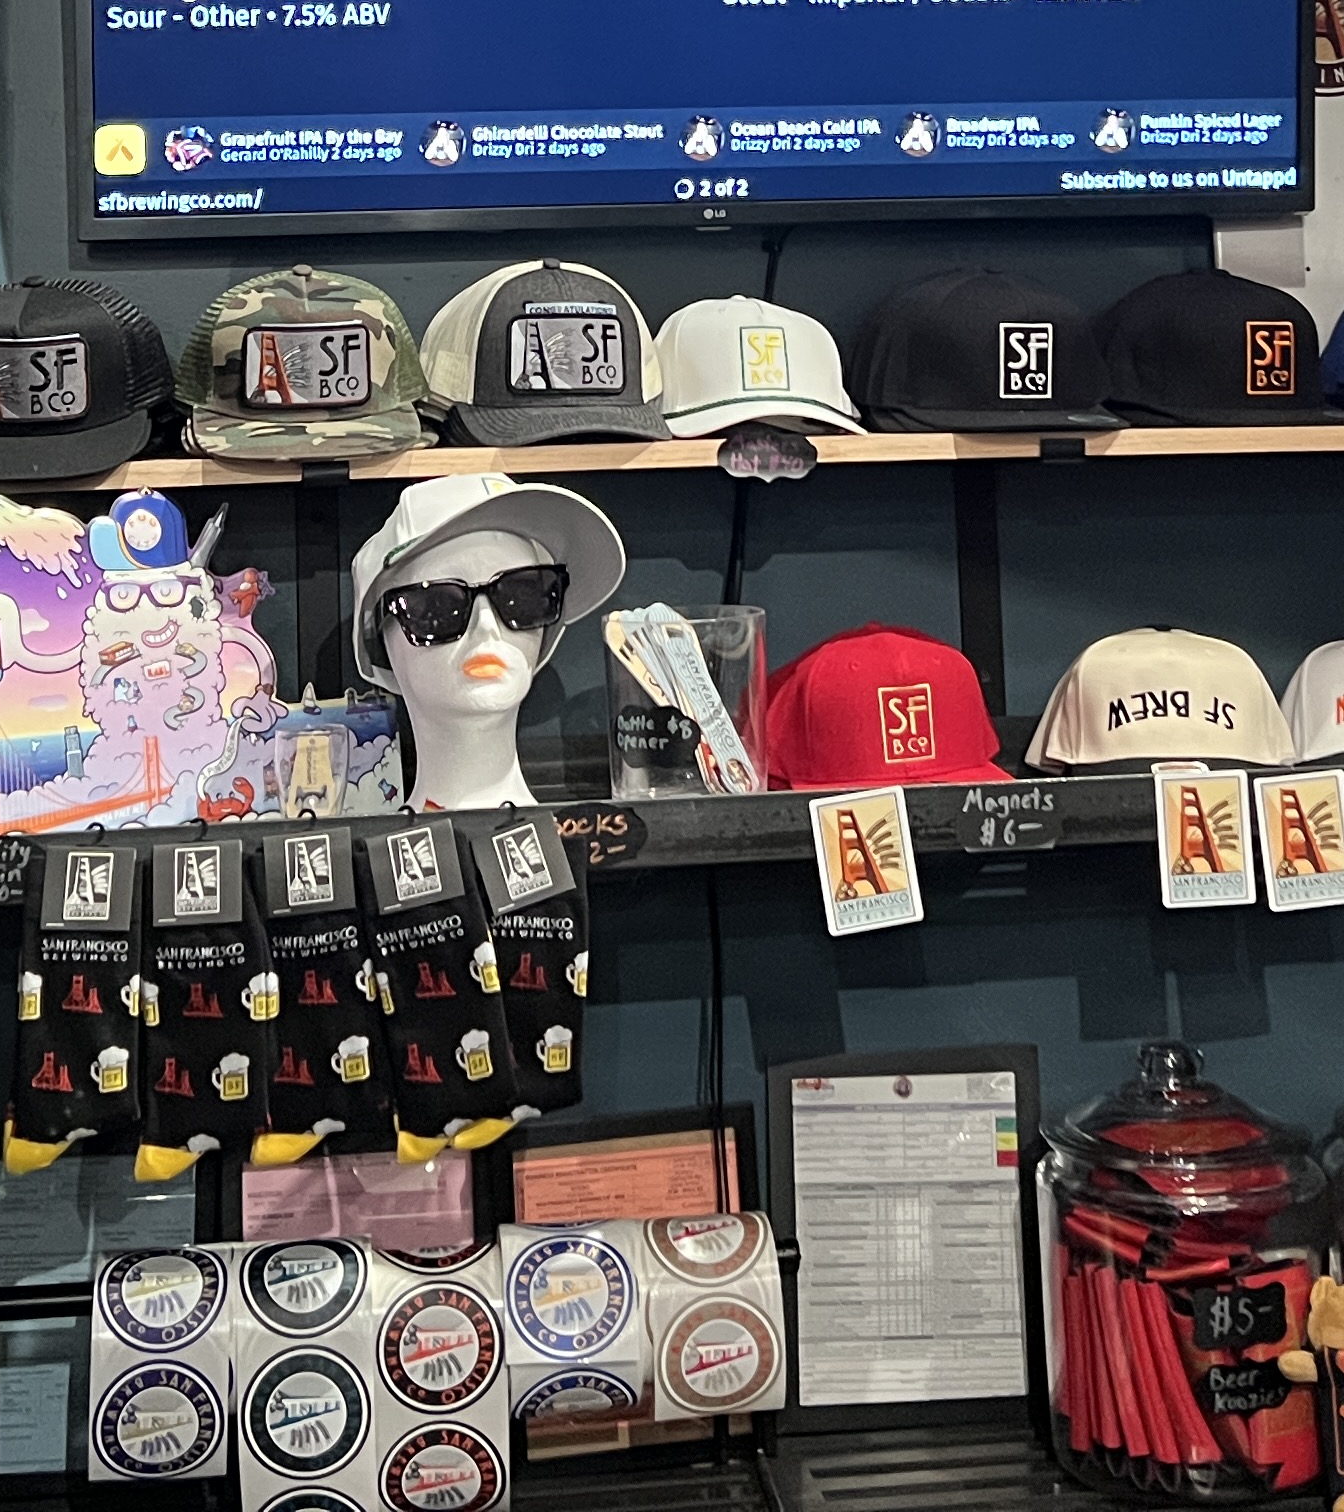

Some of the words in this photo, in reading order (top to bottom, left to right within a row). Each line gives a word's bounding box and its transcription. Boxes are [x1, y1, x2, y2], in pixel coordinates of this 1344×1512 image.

[107, 7, 166, 29] Sour
[190, 4, 261, 27] Other
[282, 3, 337, 26] 7.5%
[342, 3, 390, 25] ABV
[700, 179, 711, 196] 2
[715, 177, 735, 197] of
[736, 179, 748, 196] 2
[1061, 170, 1147, 189] Subscribe
[1148, 171, 1169, 188] to
[1172, 173, 1193, 187] us
[1196, 172, 1219, 186] on
[1222, 167, 1296, 189] Untappd
[98, 188, 263, 212] sfbrewingco.com/
[318, 334, 361, 376] SF
[581, 323, 617, 363] SF
[1008, 331, 1049, 370] SF
[1254, 330, 1291, 368] SF
[29, 347, 78, 392] SF
[889, 695, 927, 735] SF
[1107, 689, 1189, 732] BREW
[962, 787, 1054, 818] Magnets
